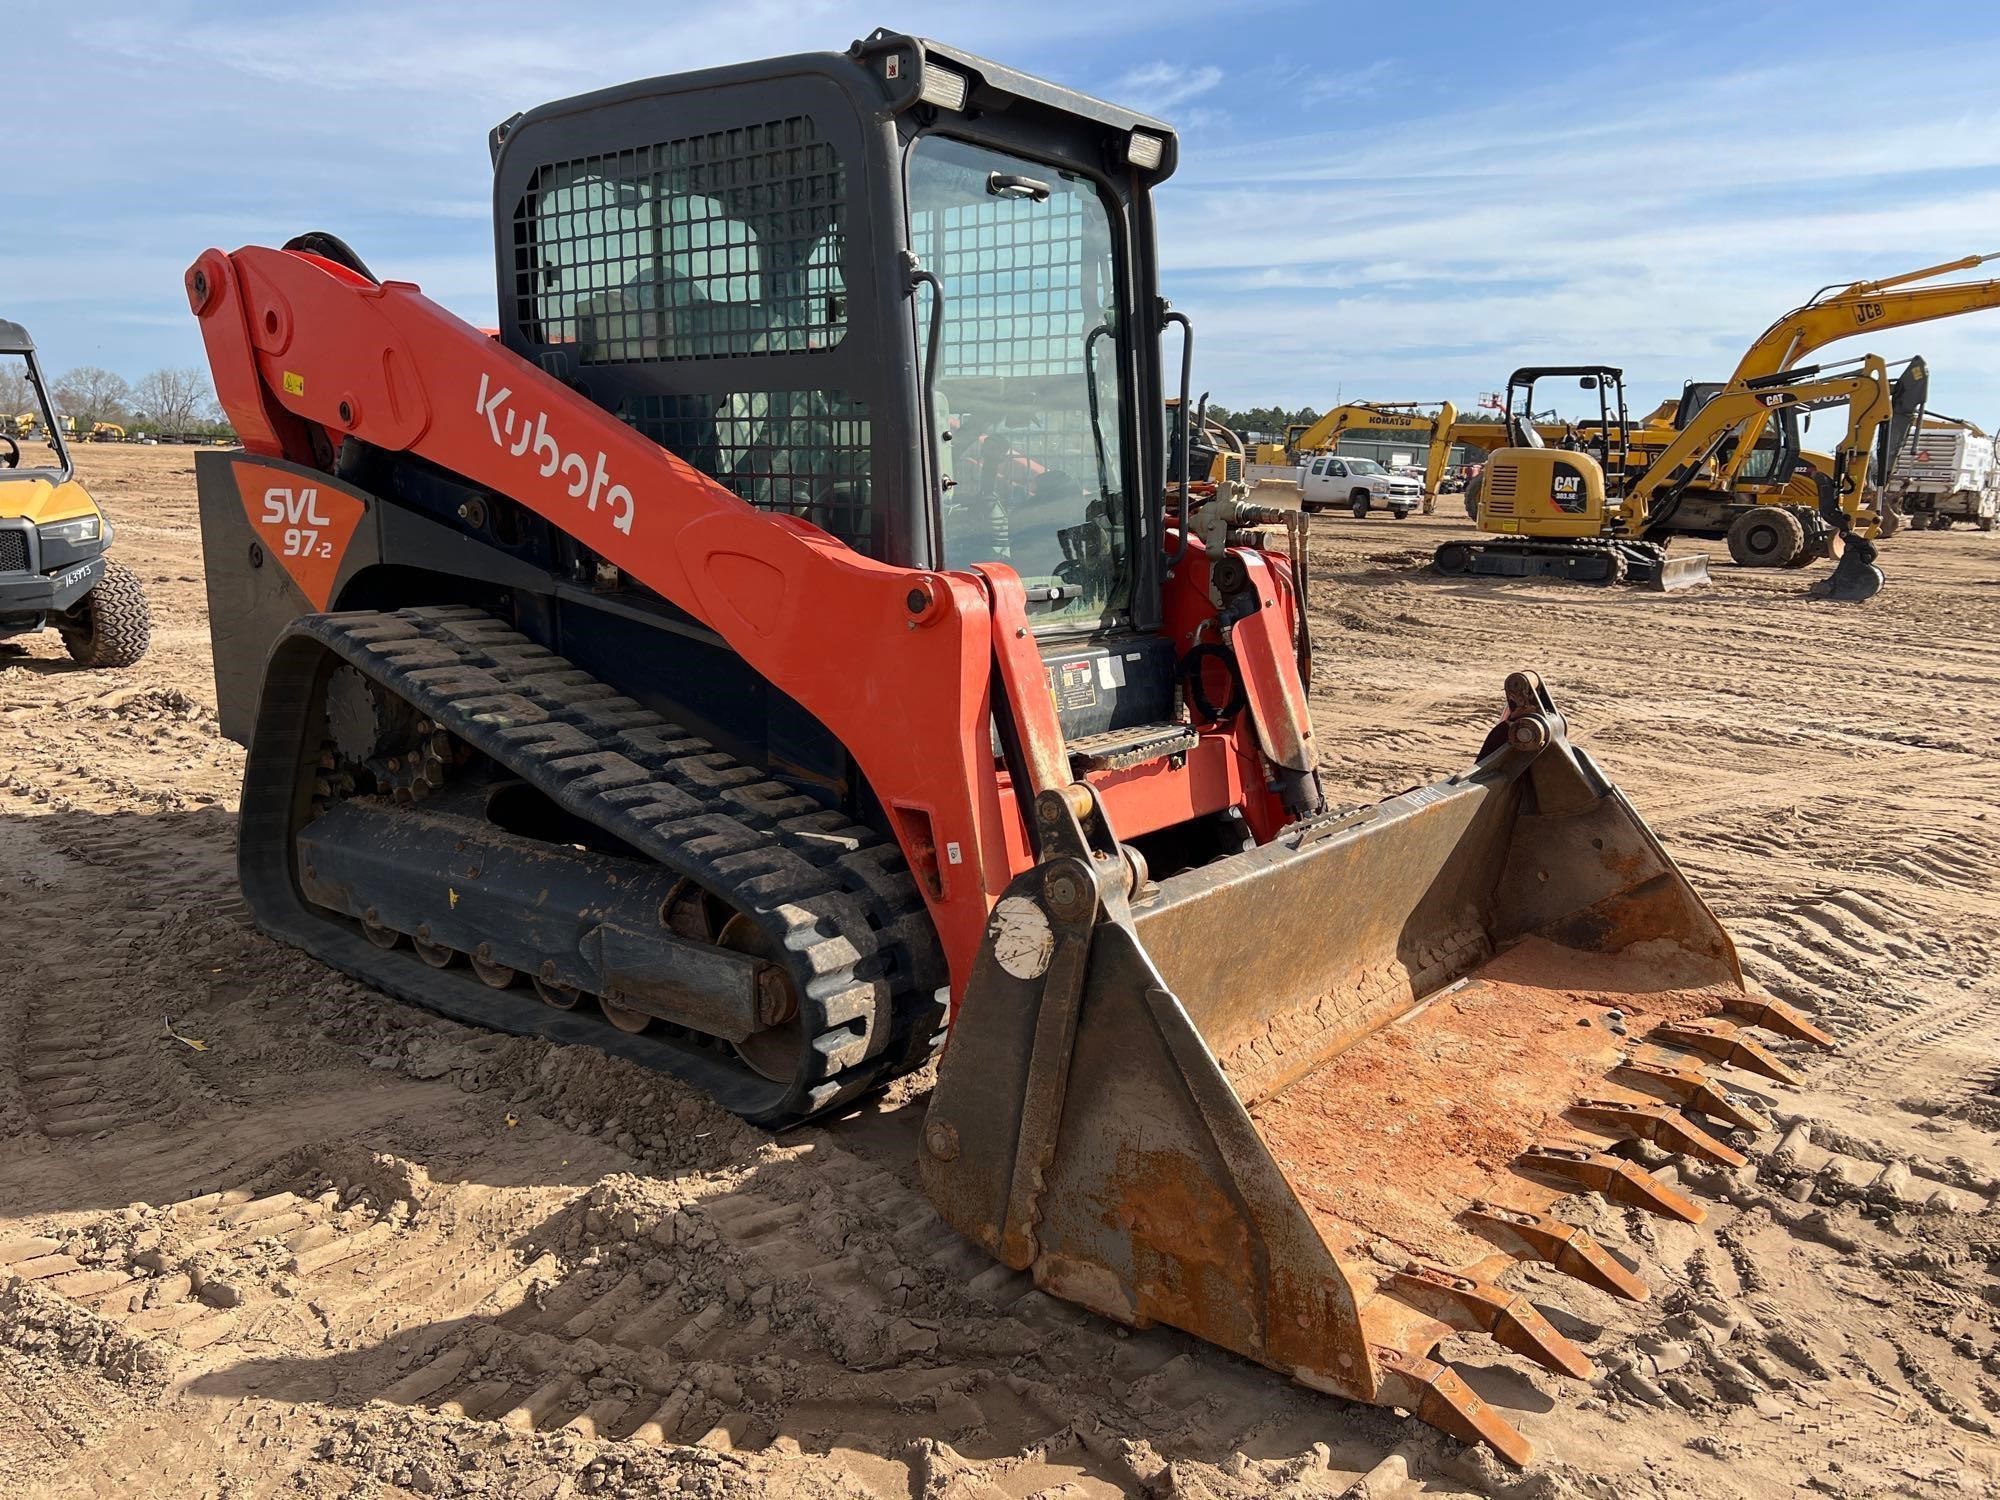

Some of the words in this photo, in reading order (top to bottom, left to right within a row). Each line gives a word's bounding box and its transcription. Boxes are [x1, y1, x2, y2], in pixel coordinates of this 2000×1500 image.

[1857, 303, 1882, 322] JCB
[1766, 393, 1783, 406] CAT
[1369, 416, 1411, 426] KOMATSU
[476, 372, 634, 536] Kubota
[1554, 476, 1580, 492] CAT
[262, 488, 330, 526] SVL
